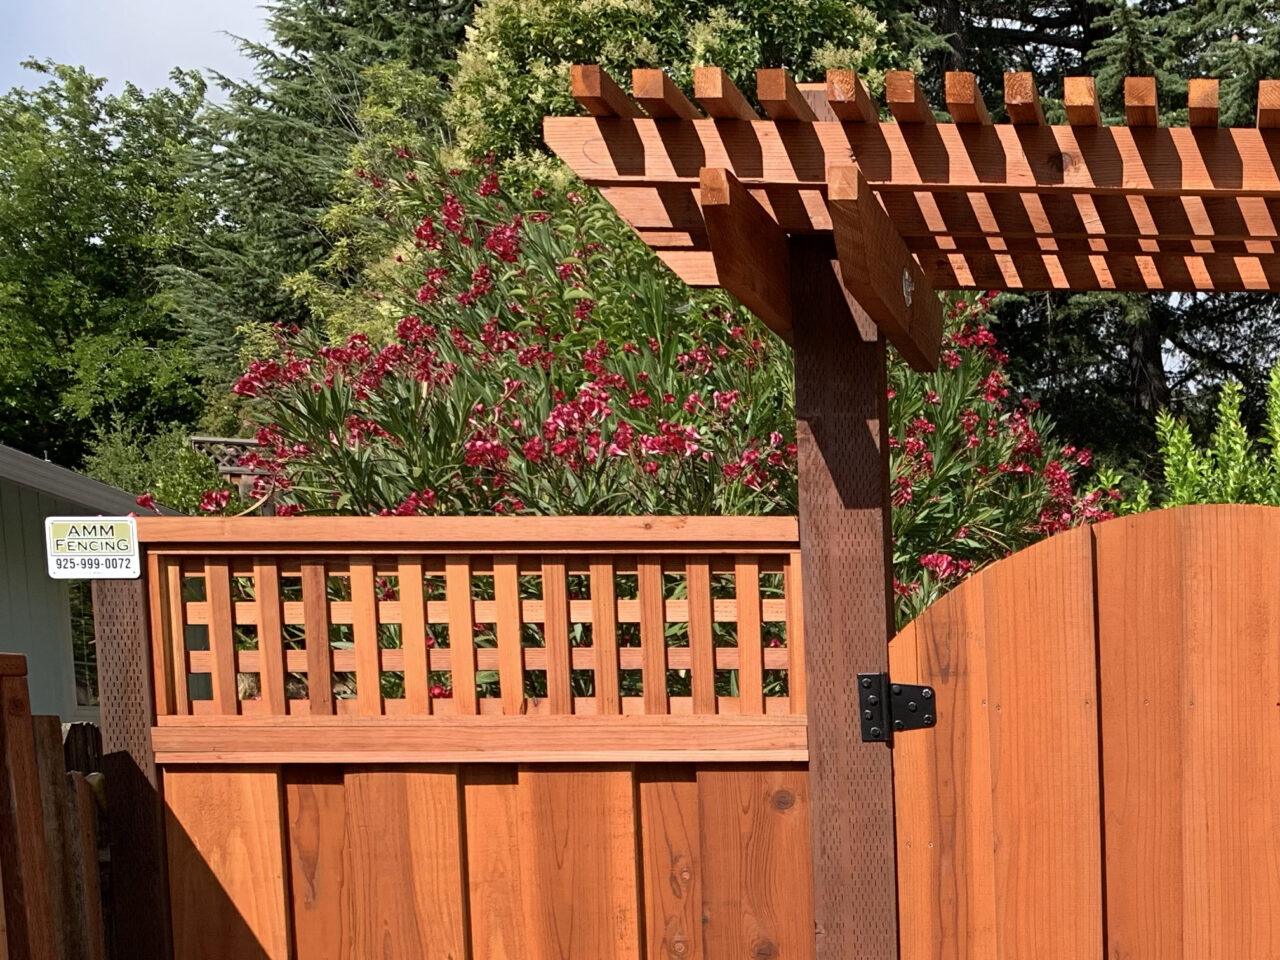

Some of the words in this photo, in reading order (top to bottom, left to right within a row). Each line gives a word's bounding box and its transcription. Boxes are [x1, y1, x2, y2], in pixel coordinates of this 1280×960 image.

[68, 525, 114, 536] AMM
[56, 539, 129, 551] FENCING
[56, 558, 131, 569] 925-999-0072
